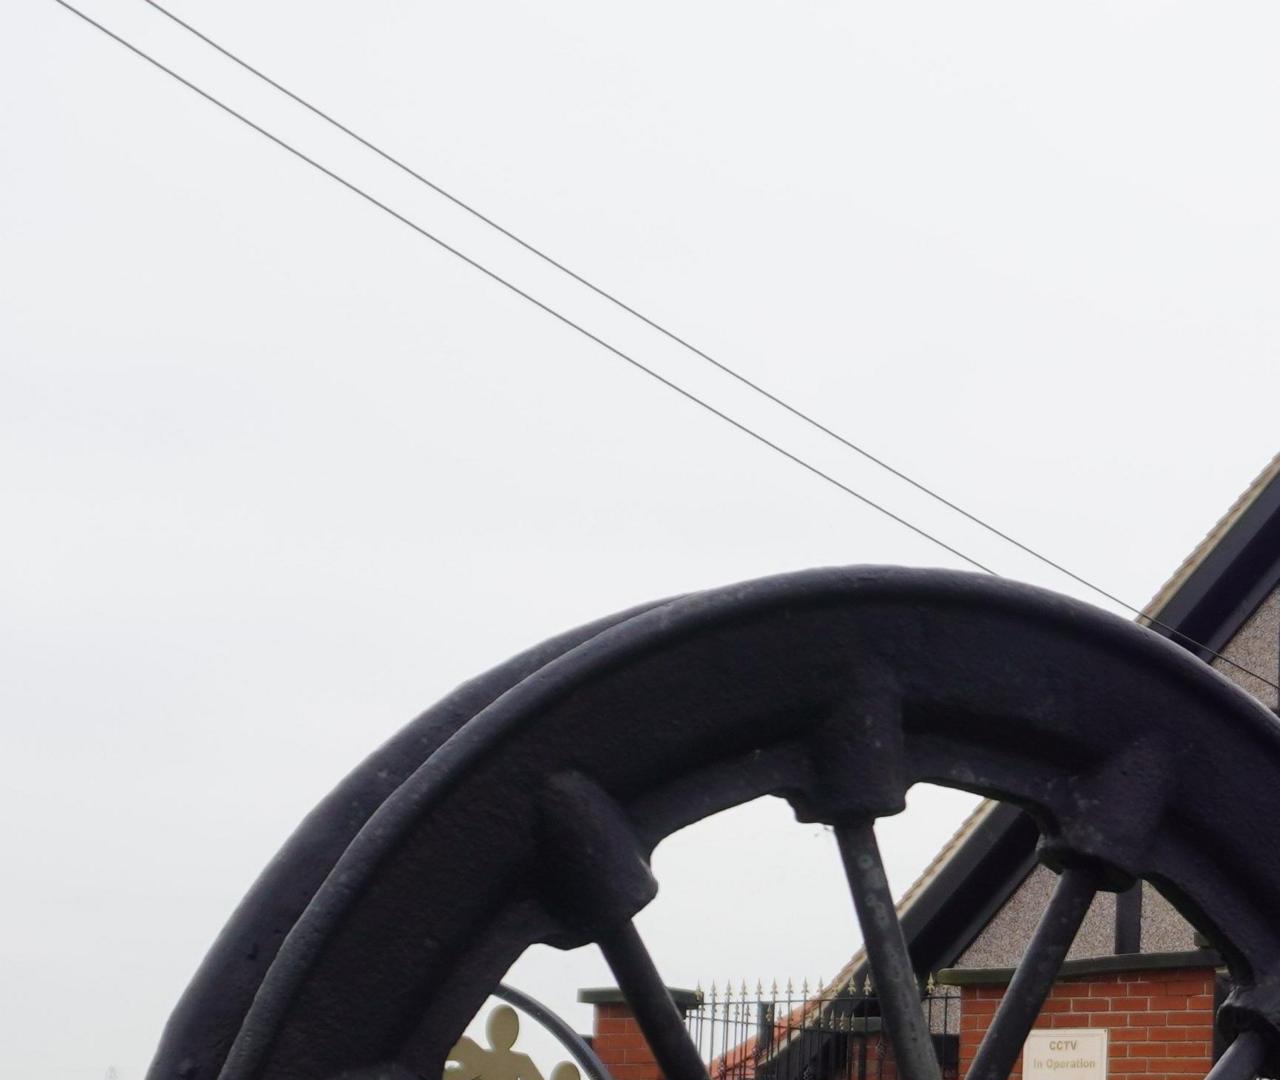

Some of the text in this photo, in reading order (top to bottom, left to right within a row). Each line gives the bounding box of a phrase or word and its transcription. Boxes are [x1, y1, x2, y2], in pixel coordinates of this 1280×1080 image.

[1049, 1040, 1077, 1050] CCTV
[1033, 1058, 1096, 1070] In Operation
